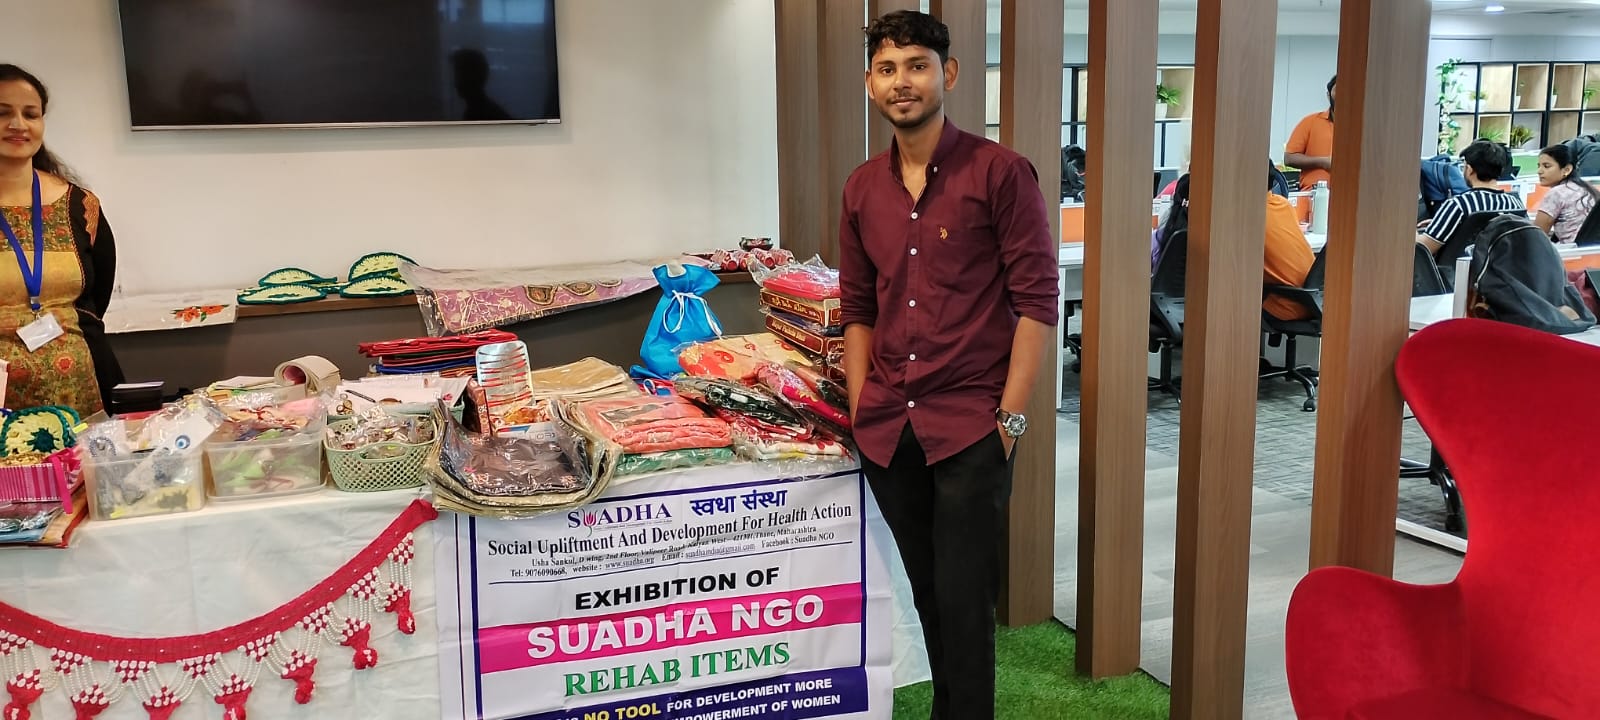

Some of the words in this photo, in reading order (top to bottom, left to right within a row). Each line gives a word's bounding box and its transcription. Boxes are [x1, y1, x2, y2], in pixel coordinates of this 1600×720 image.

[567, 502, 673, 529] SUADHA
[690, 494, 736, 518] स्वधा
[741, 489, 788, 512] संस्था
[488, 539, 533, 557] Social
[537, 535, 613, 558] Upliftment
[617, 528, 647, 546] And
[652, 519, 738, 544] Development
[742, 515, 764, 530] For
[767, 507, 807, 526] Health
[811, 502, 852, 521] Action
[531, 557, 551, 567] Usha
[551, 554, 578, 567] Sankul,
[605, 552, 619, 560] 2nd
[711, 536, 726, 545] West
[777, 525, 817, 537] Maharashtra
[510, 569, 524, 577] Tel:
[573, 564, 597, 574] website
[605, 556, 655, 569] www.suadha.org
[661, 551, 681, 562] Email
[761, 536, 790, 549] Facebook
[794, 533, 817, 545] Suadha
[818, 531, 835, 541] NGO
[575, 572, 737, 610] EXHIBITION
[746, 567, 780, 586] OF
[527, 606, 717, 659] SUADHA
[732, 595, 825, 631] NGO
[564, 658, 681, 697] REHAB
[691, 642, 790, 678] ITEMS
[584, 710, 610, 720] NO
[615, 702, 661, 720] TOOL
[667, 698, 693, 713] FOR
[695, 682, 791, 707] DEVELOPMENT
[795, 677, 833, 693] MORE
[671, 703, 768, 720] OWERMENT
[771, 700, 788, 712] OF
[791, 694, 841, 710] WOMEN
